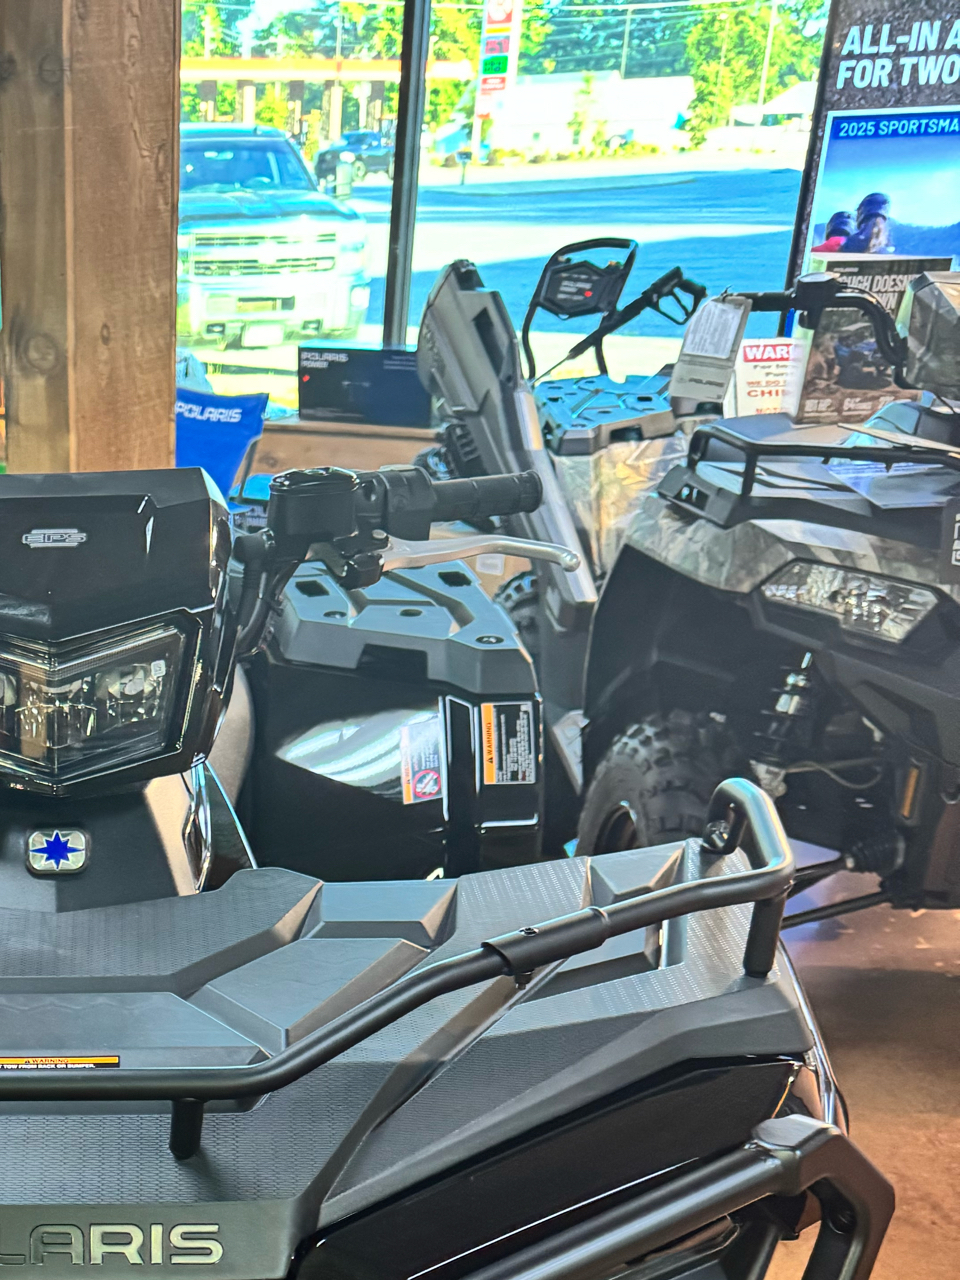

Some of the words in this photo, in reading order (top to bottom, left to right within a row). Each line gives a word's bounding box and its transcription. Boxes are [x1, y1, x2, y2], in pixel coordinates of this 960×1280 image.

[841, 20, 941, 55] ALL-IN
[836, 58, 893, 89] FOR
[899, 54, 960, 86] TWO
[839, 121, 876, 137] 2025
[840, 275, 872, 292] OUGH
[174, 400, 243, 423] POLARIS
[485, 722, 493, 755] WARNING
